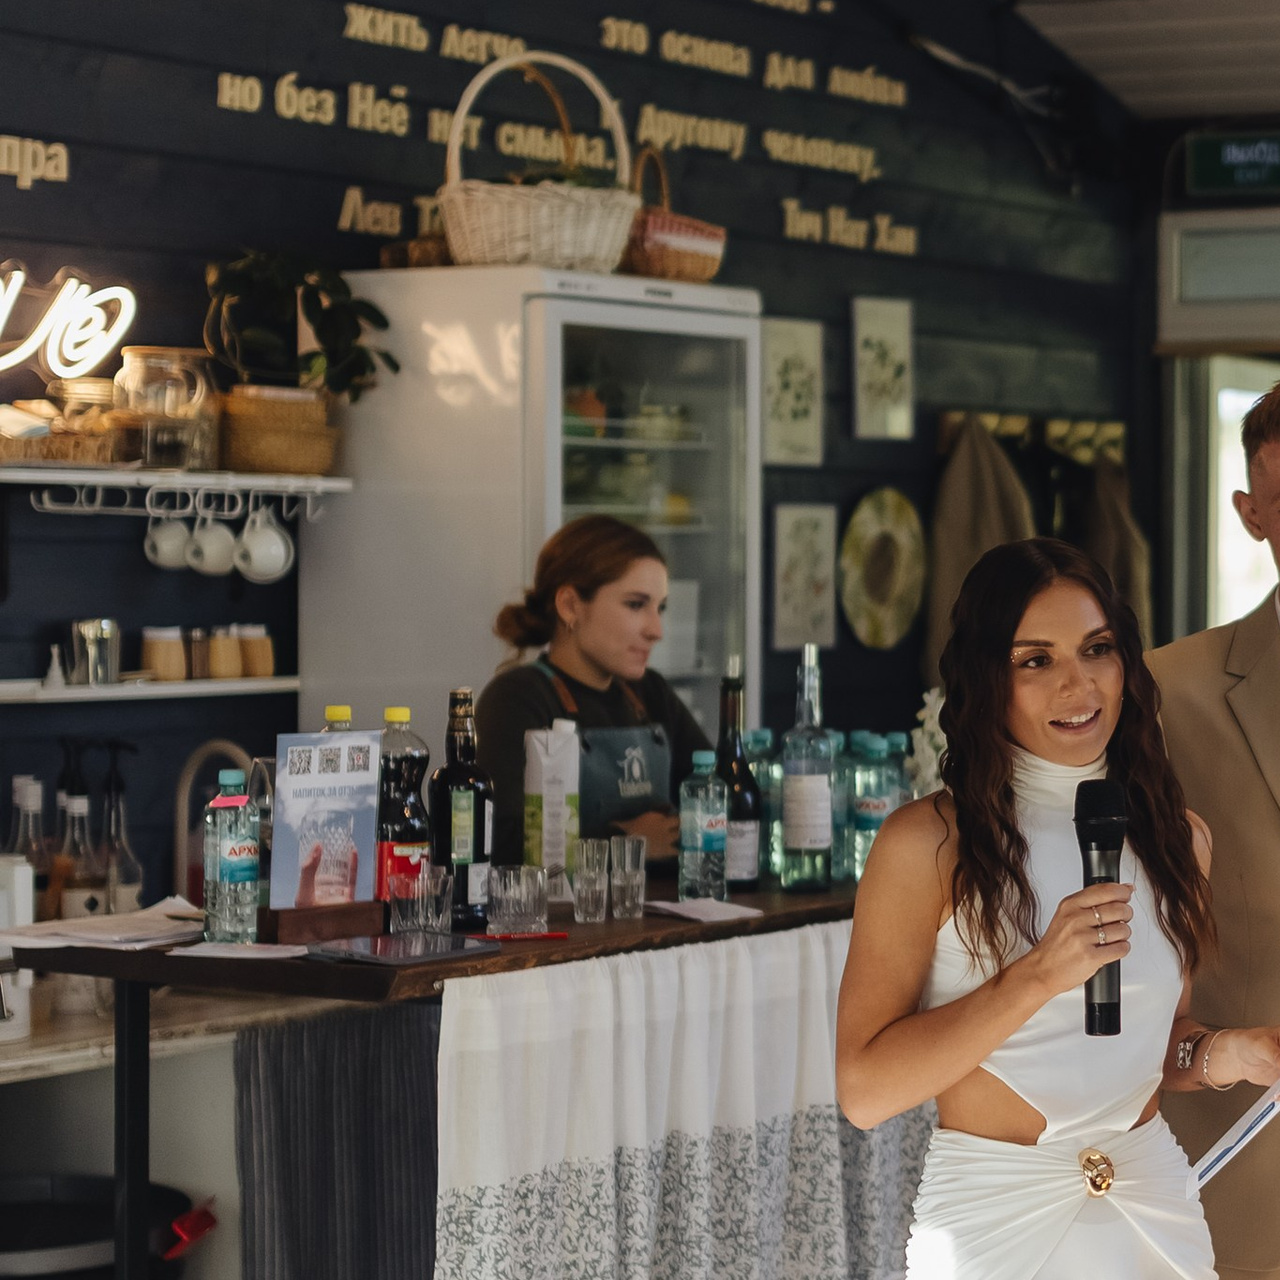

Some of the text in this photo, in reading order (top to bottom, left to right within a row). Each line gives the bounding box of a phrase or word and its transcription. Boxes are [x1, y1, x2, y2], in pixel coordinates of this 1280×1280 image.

[599, 17, 649, 56] это
[659, 30, 752, 78] основа
[217, 72, 263, 113] но
[274, 71, 336, 126] без
[347, 81, 411, 138] Неё
[427, 108, 484, 151] нт
[337, 186, 402, 237] Лев
